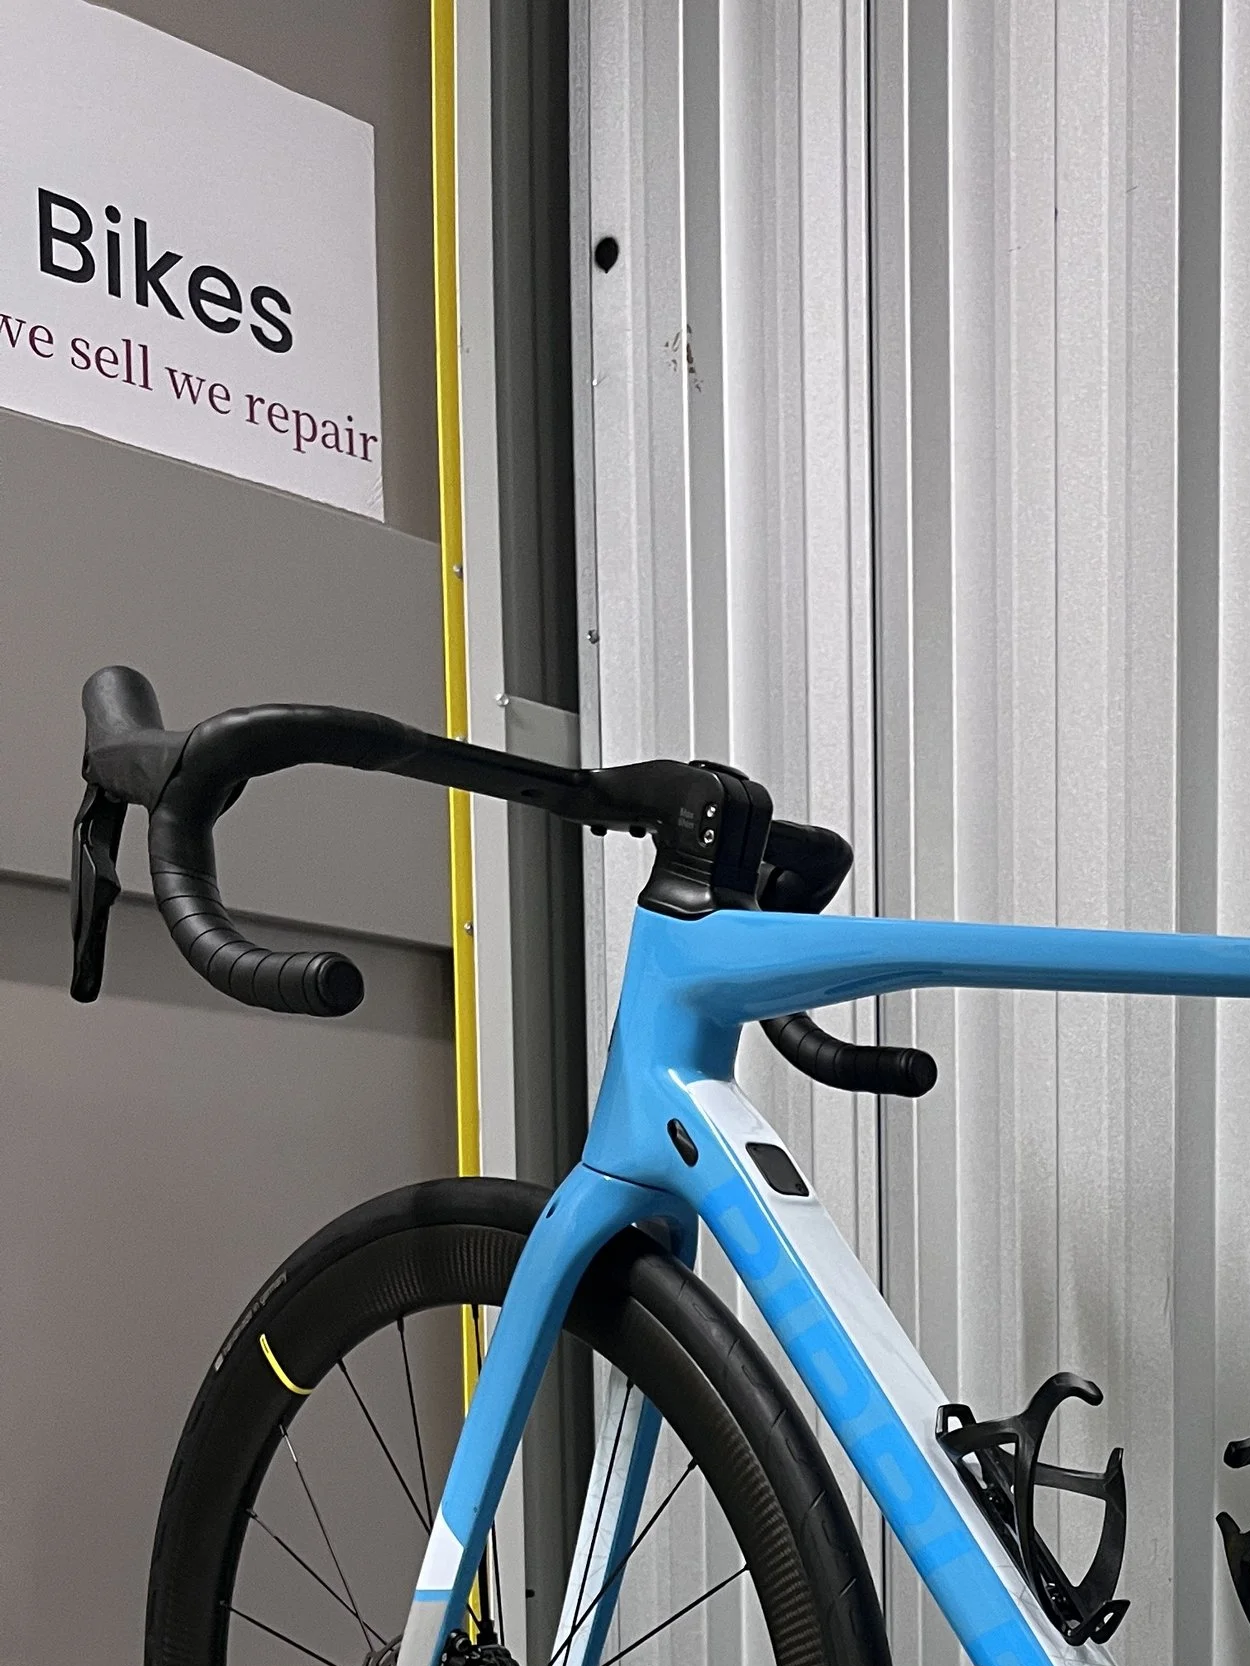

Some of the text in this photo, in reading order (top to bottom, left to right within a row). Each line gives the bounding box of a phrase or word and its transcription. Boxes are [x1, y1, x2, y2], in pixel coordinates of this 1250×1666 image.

[38, 187, 293, 354] Bikes
[70, 337, 153, 391] sell
[164, 366, 232, 414] we
[245, 393, 378, 463] repair
